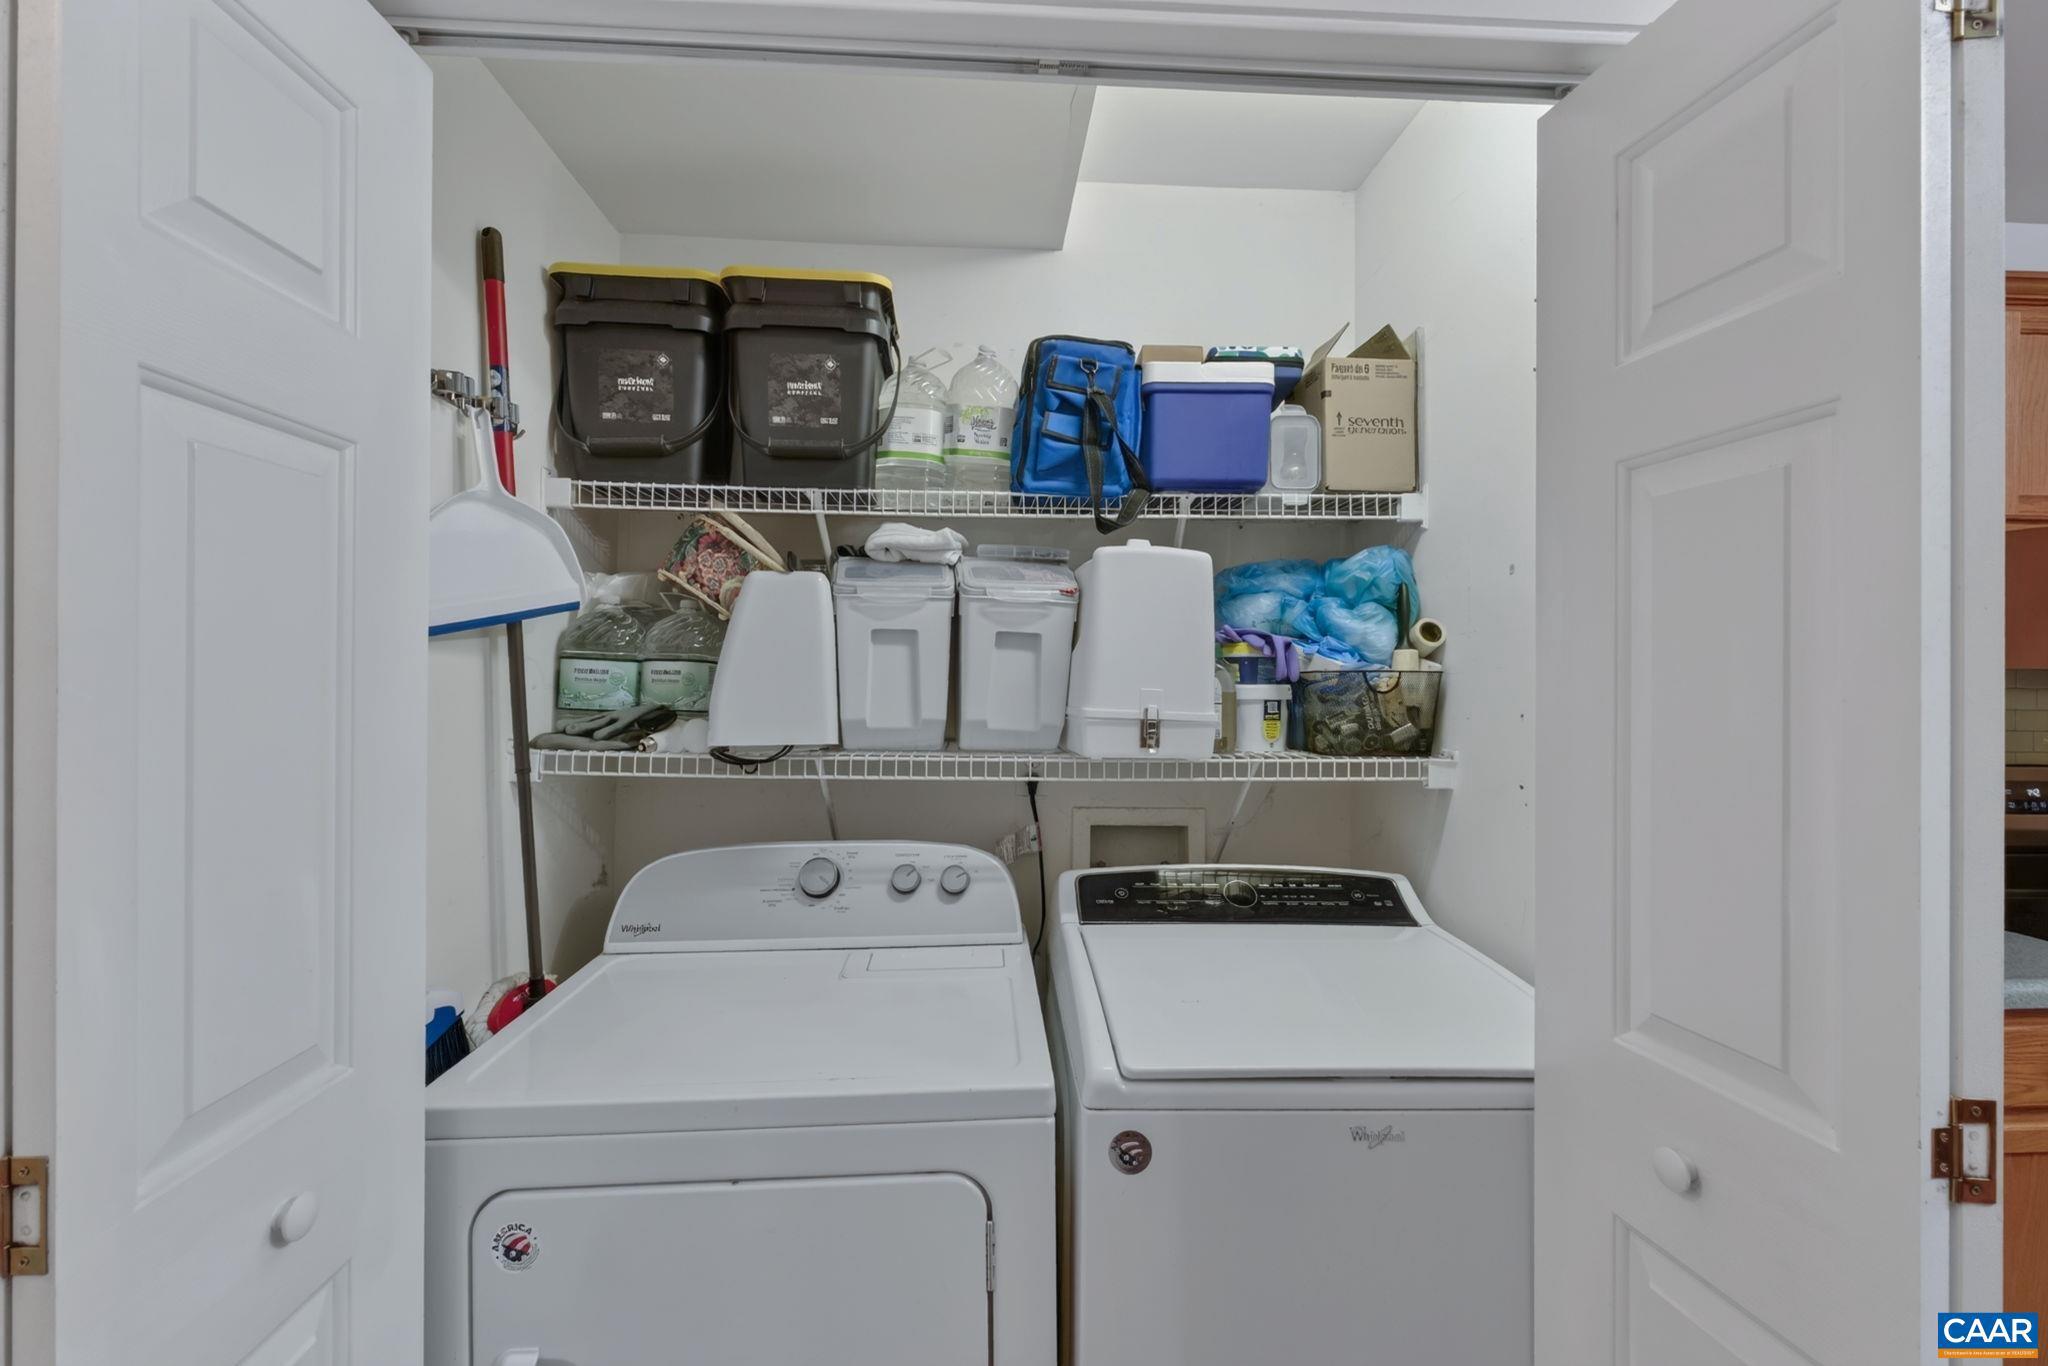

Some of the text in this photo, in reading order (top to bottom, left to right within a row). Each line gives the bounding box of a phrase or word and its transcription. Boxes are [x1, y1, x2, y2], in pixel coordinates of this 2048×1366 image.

[1364, 364, 1370, 374] 6
[1348, 416, 1404, 428] seventh
[621, 921, 661, 937] Whirlpool
[1349, 1125, 1405, 1150] Whirlpool
[491, 1223, 532, 1252] AMERICA
